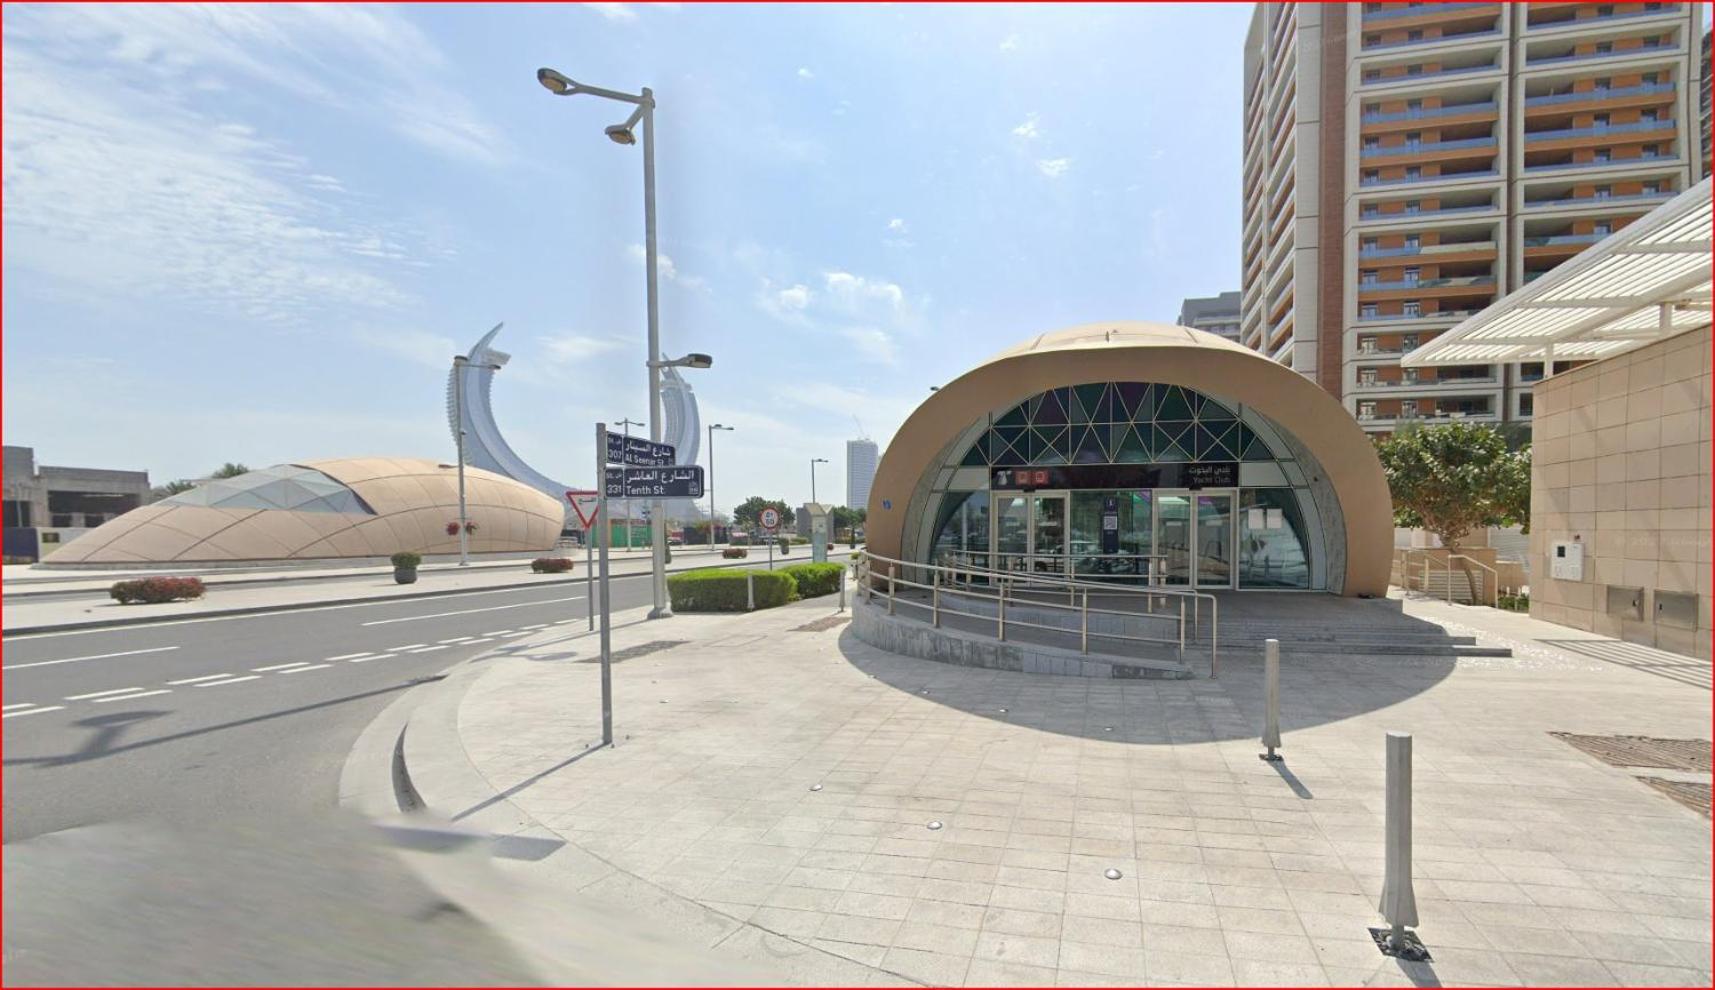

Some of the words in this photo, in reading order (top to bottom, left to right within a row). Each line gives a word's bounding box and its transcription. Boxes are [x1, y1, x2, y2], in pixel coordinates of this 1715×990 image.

[627, 470, 657, 483] العاشر
[661, 470, 694, 483] الشارع
[607, 484, 622, 494] 331
[626, 485, 651, 494] Tenth
